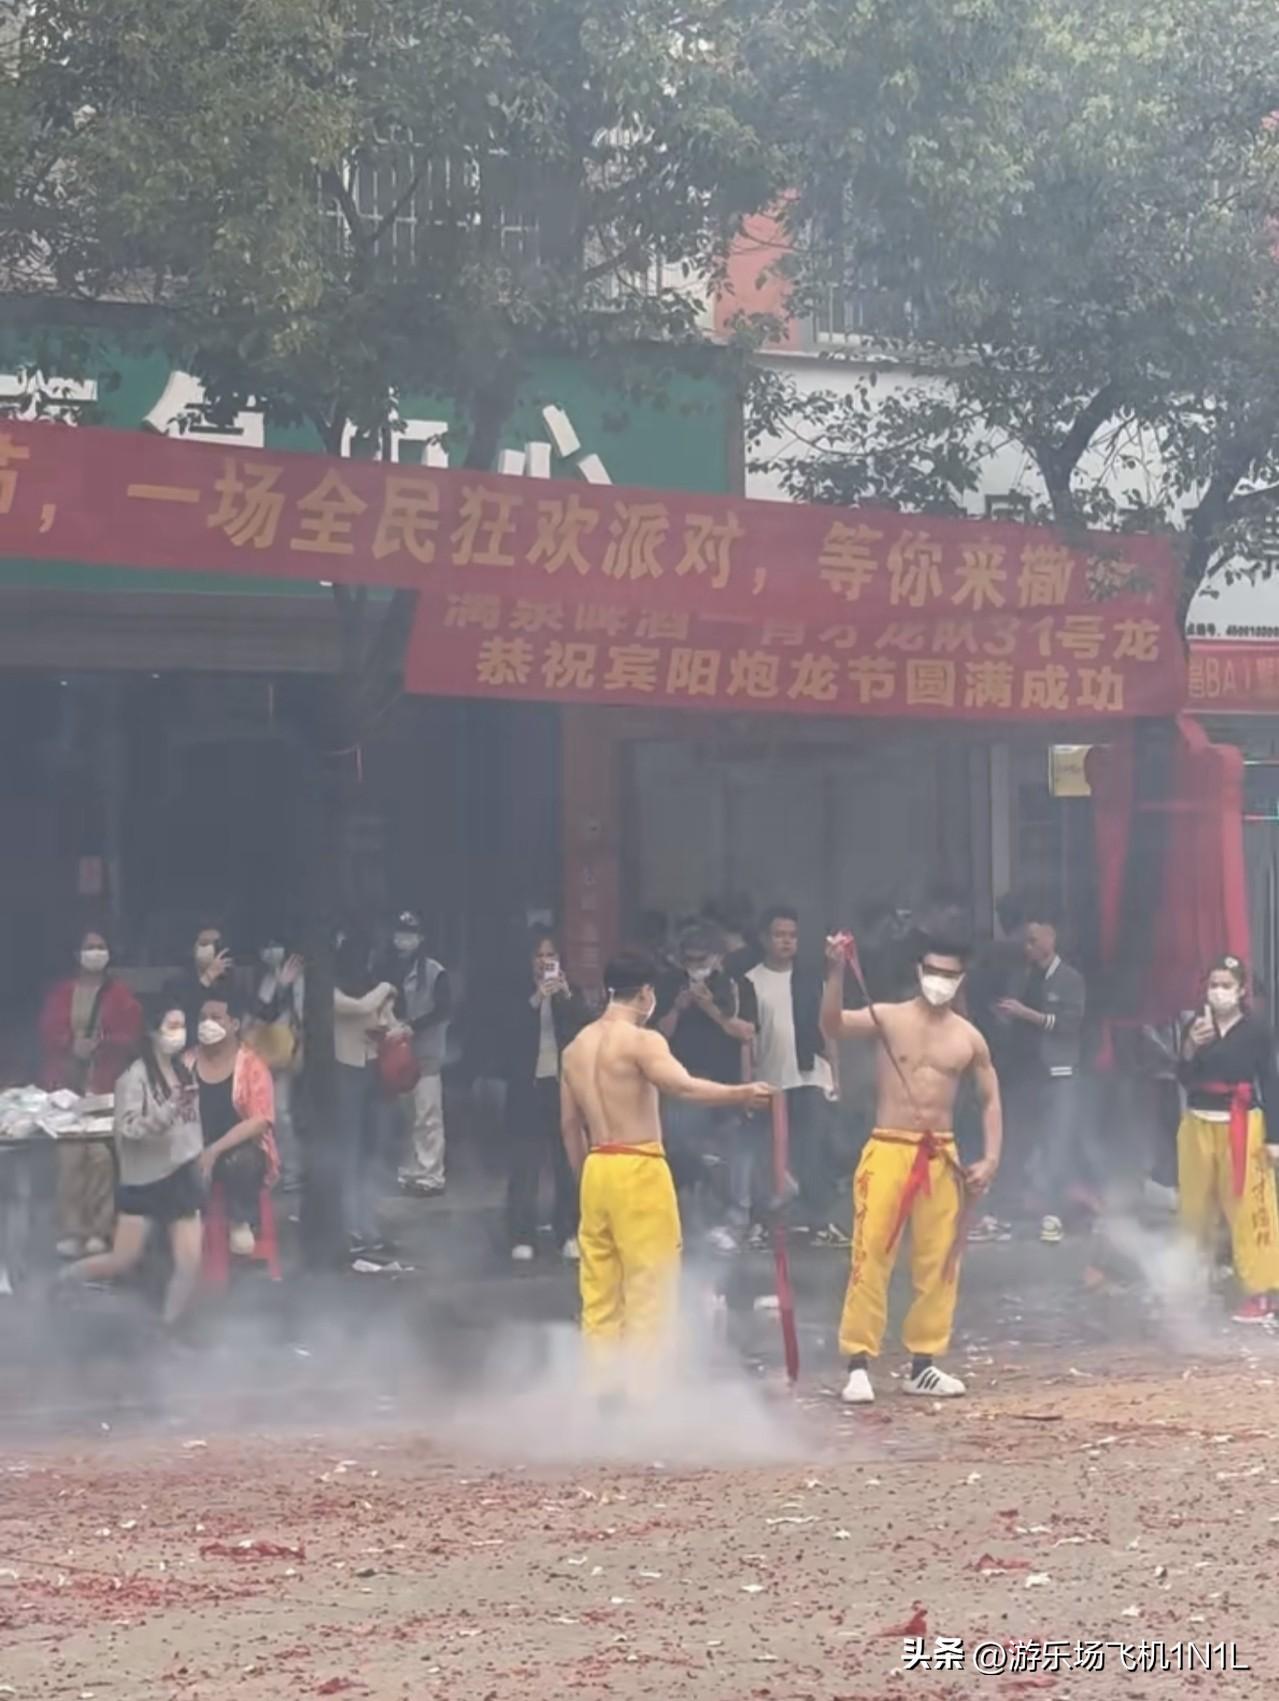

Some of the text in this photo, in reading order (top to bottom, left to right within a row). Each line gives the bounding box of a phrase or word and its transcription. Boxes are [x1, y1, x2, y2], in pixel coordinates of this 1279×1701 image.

[476, 636, 1126, 712] 恭祝宾阳炮龙节圆满成功
